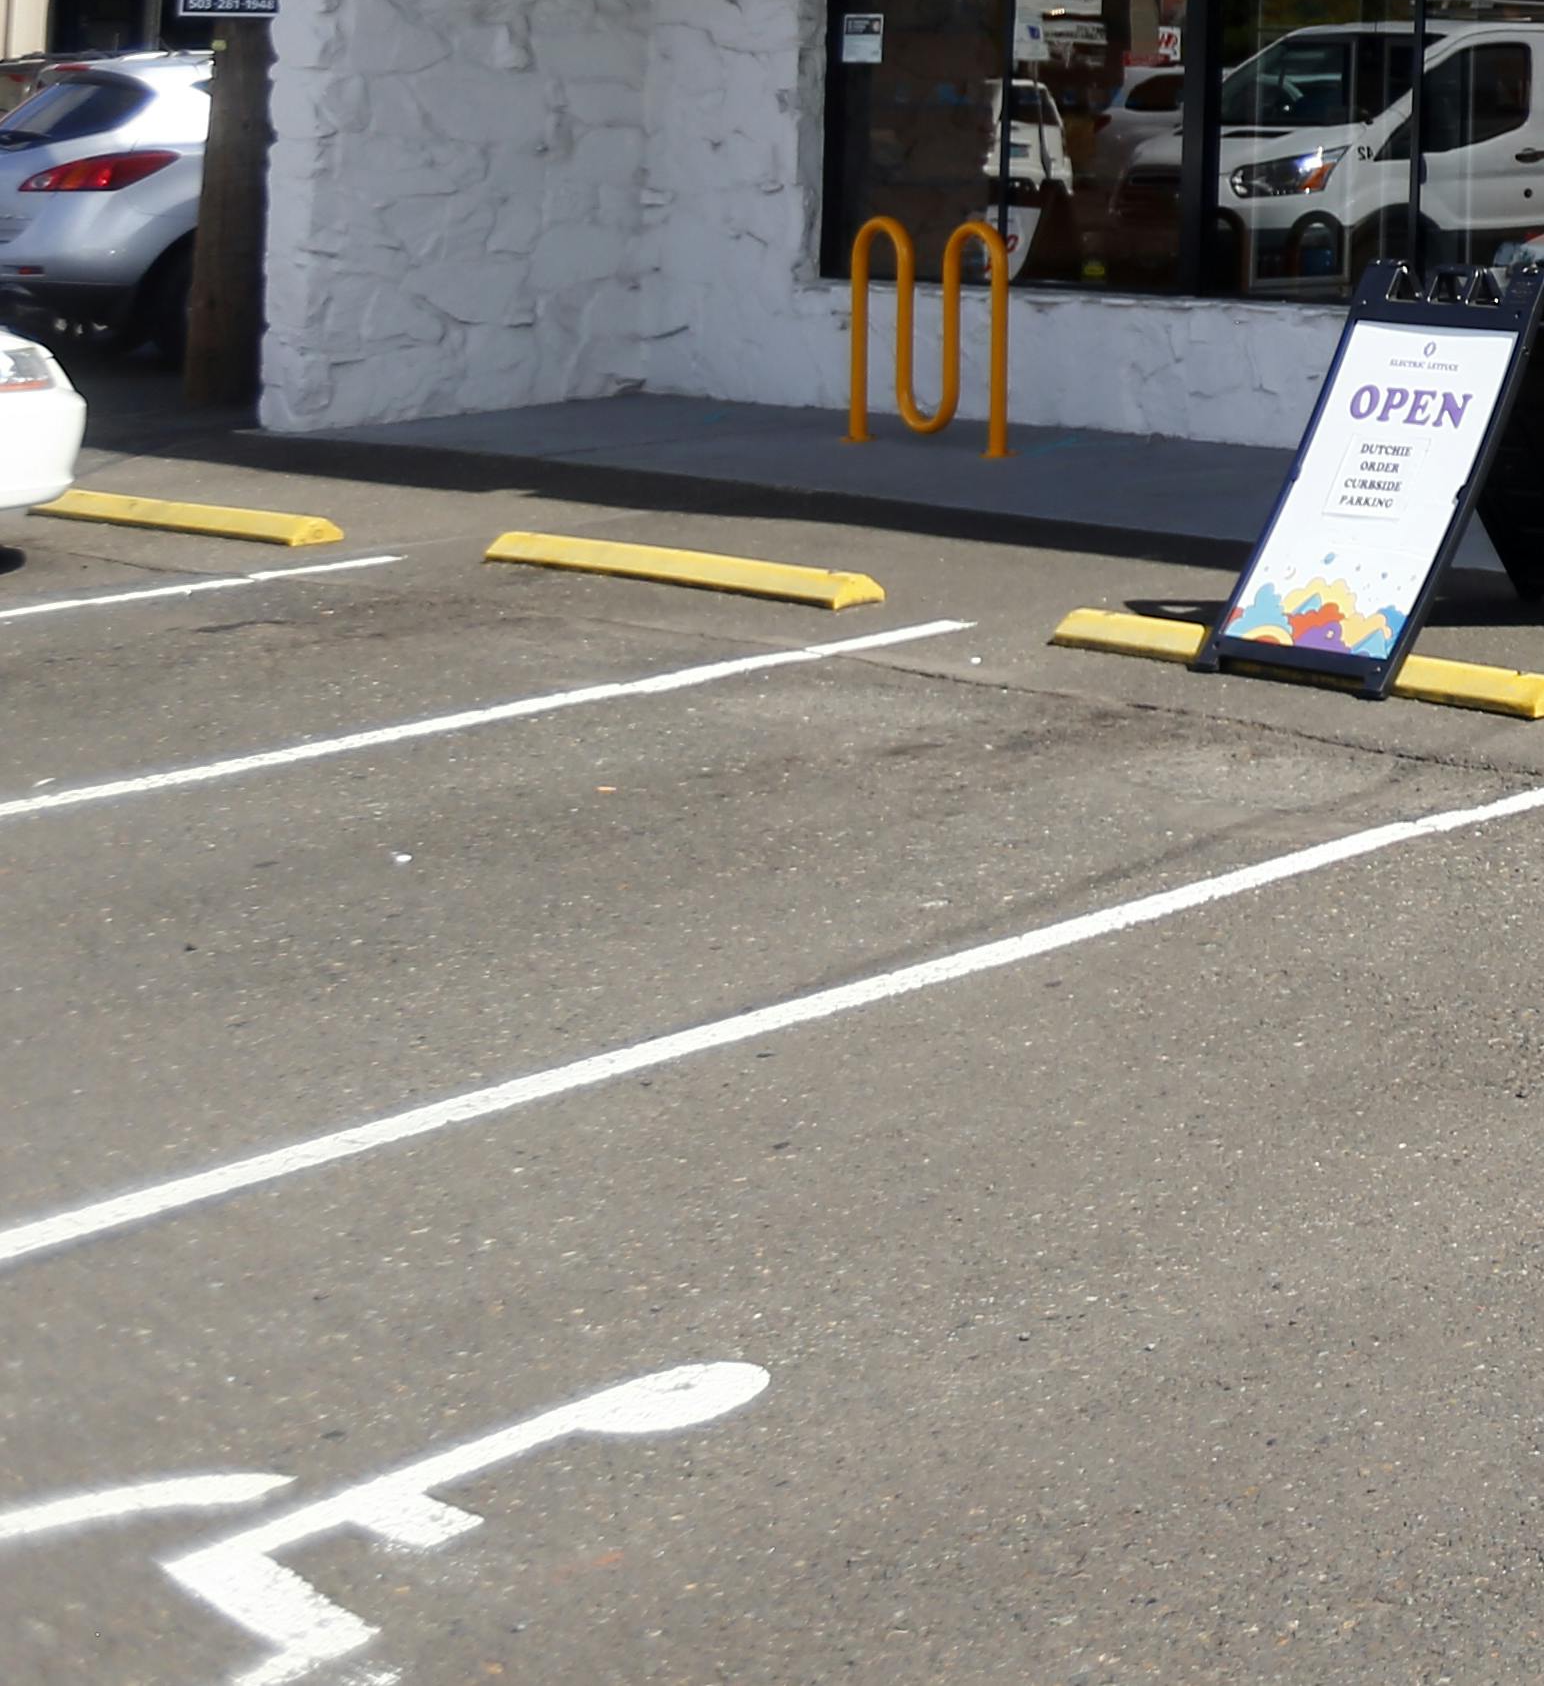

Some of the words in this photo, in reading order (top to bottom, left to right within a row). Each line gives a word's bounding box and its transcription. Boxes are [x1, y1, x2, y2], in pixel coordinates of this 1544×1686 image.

[1389, 358, 1424, 369] ELECTRIC
[1427, 362, 1459, 372] LETTUCE
[1350, 384, 1473, 429] OPEN
[1360, 443, 1412, 457] DUTCHIE
[1360, 461, 1400, 473] ORDER
[1344, 478, 1402, 492] CURBSIDE
[1339, 495, 1393, 508] PARKING
